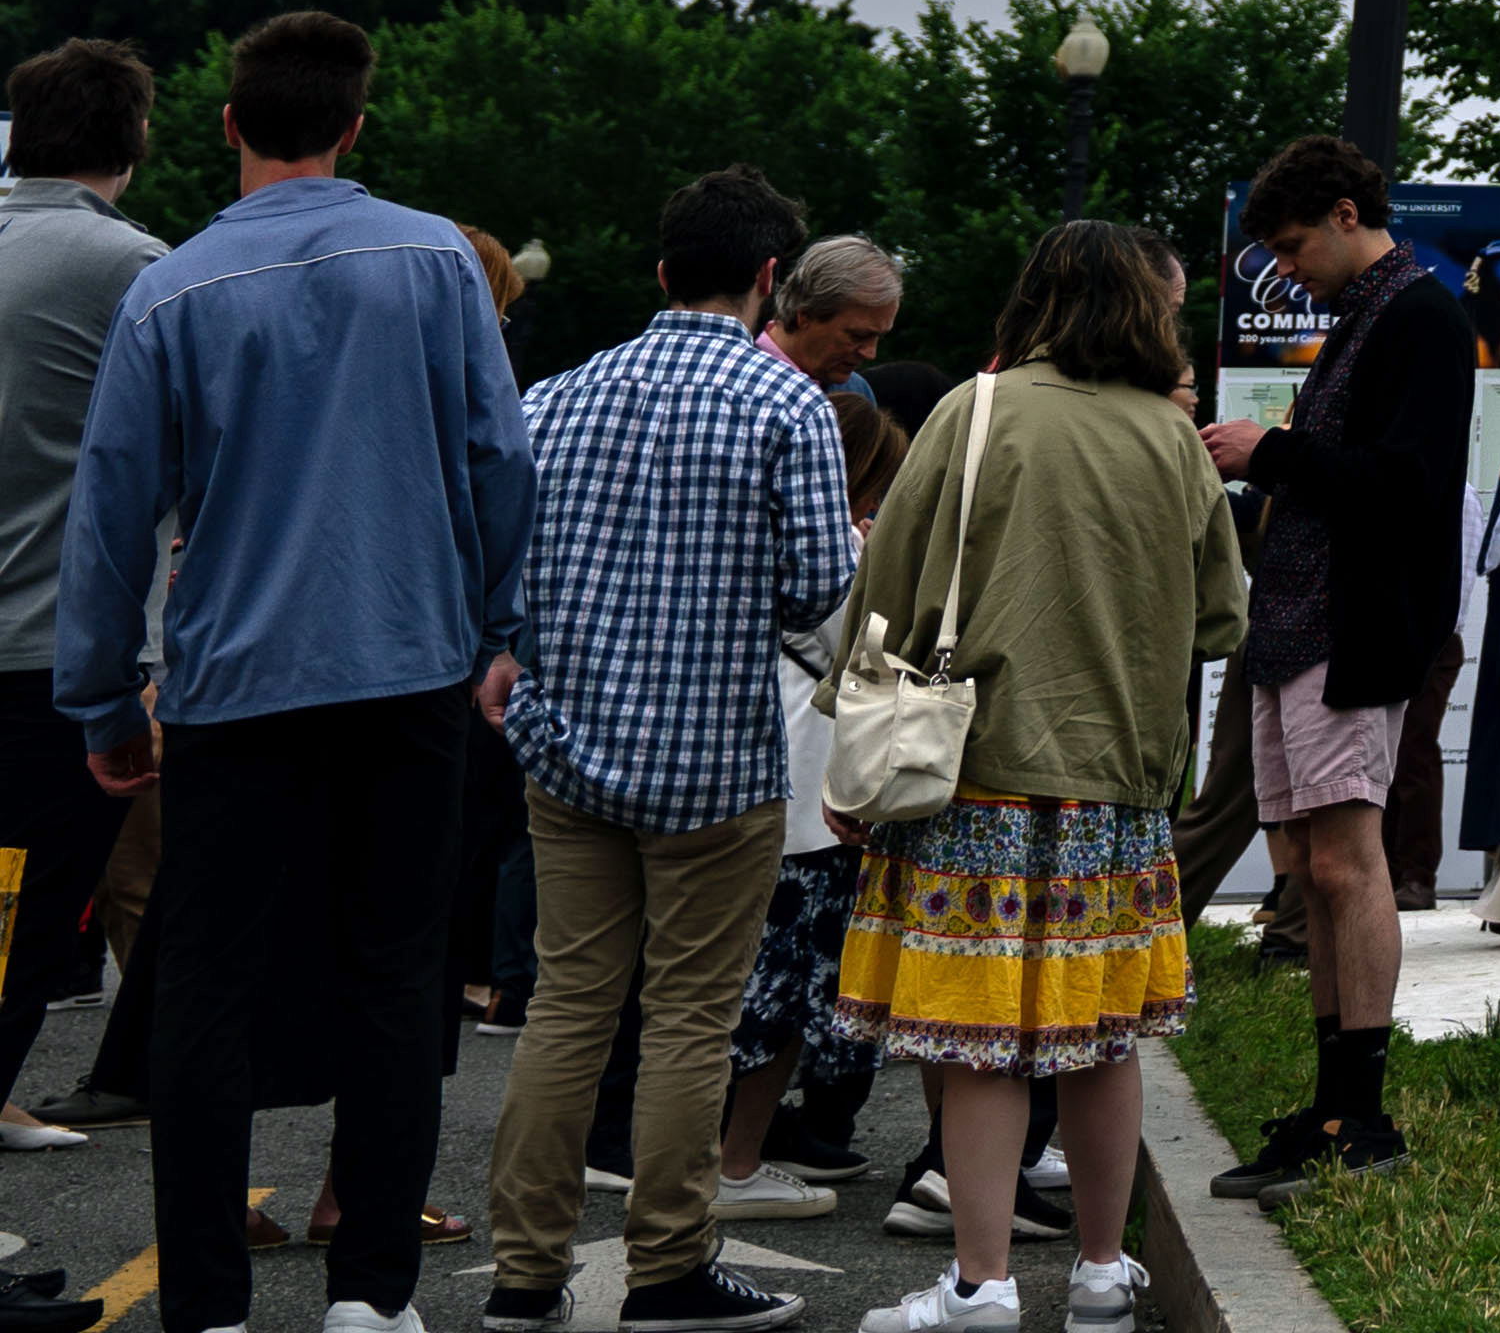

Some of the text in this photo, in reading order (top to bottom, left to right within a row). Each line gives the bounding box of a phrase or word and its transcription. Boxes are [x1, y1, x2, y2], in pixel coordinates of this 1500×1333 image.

[1409, 204, 1462, 213] UNIVERSITY
[1237, 313, 1341, 329] COMME
[1238, 334, 1258, 343] 200
[1260, 335, 1286, 345] years
[1287, 334, 1298, 343] of
